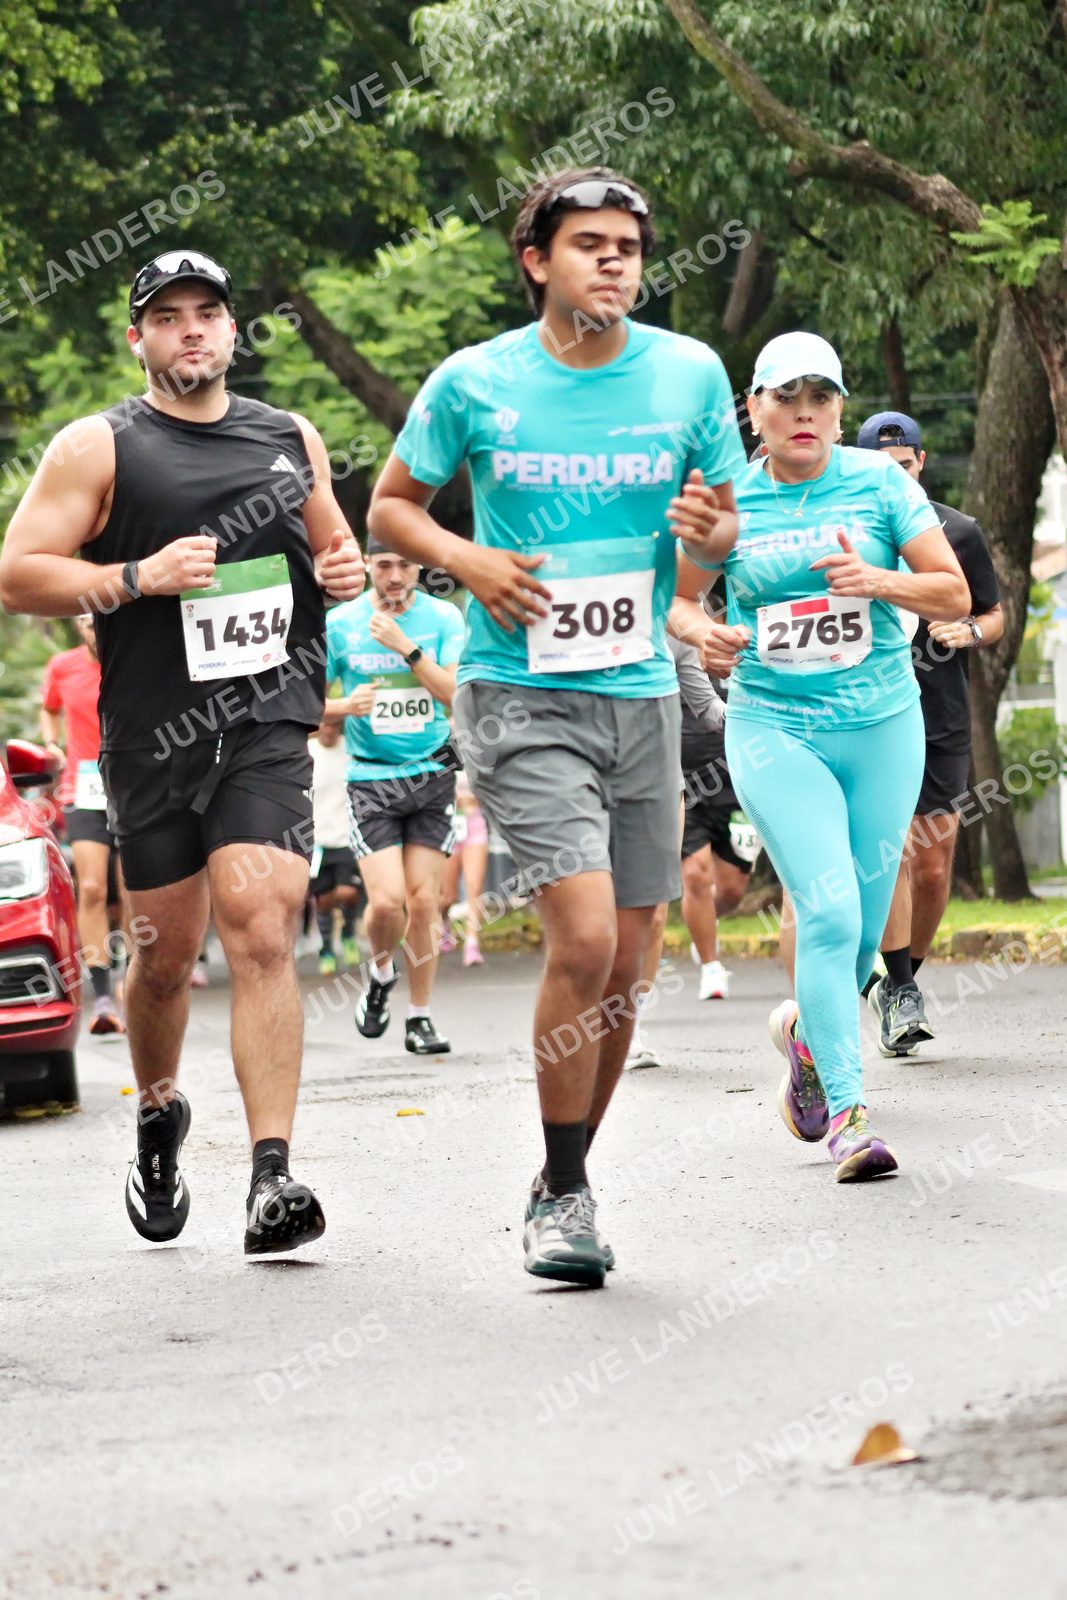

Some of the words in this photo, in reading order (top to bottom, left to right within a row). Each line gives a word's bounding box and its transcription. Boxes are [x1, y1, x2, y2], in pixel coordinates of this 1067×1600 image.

[493, 451, 673, 486] PERDURA
[197, 607, 287, 651] 1434
[552, 597, 635, 639] 308
[768, 611, 863, 651] 2765
[348, 648, 438, 671] PERDA
[376, 699, 429, 718] 2060
